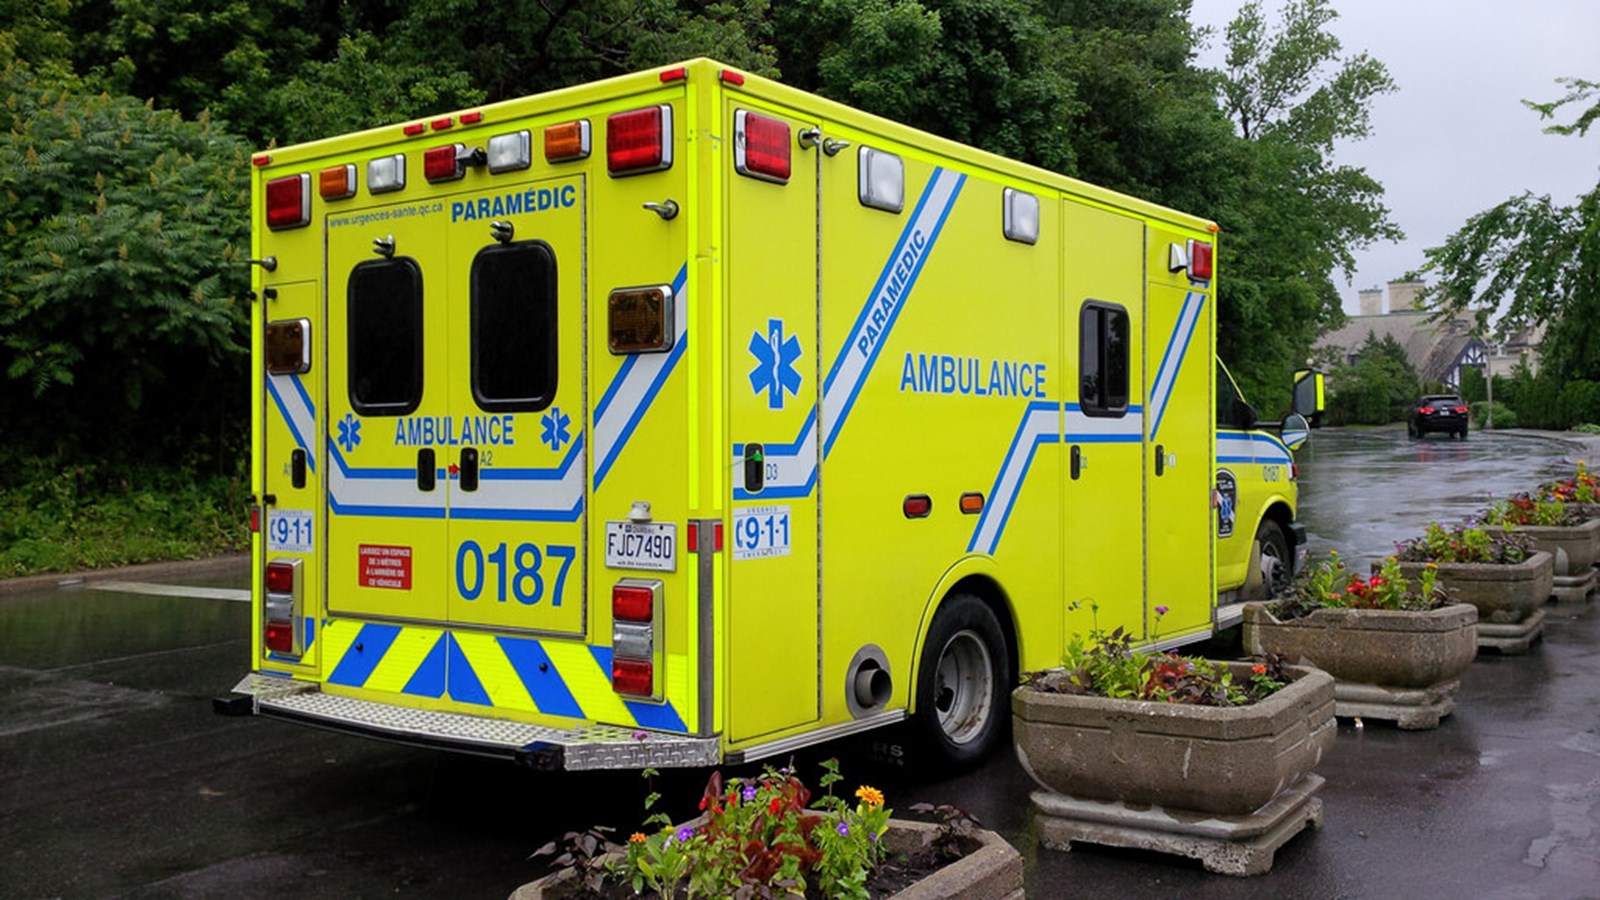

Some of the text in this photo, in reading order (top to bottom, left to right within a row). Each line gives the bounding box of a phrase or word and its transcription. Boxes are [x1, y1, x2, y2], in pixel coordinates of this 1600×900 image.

[452, 185, 575, 222] PARAMÉDIC
[857, 229, 925, 358] PARAMEDIC
[900, 353, 1047, 398] AMBULANCE
[395, 415, 514, 446] AMBULANCE
[608, 533, 672, 559] FJC7490
[455, 540, 576, 607] 0187
